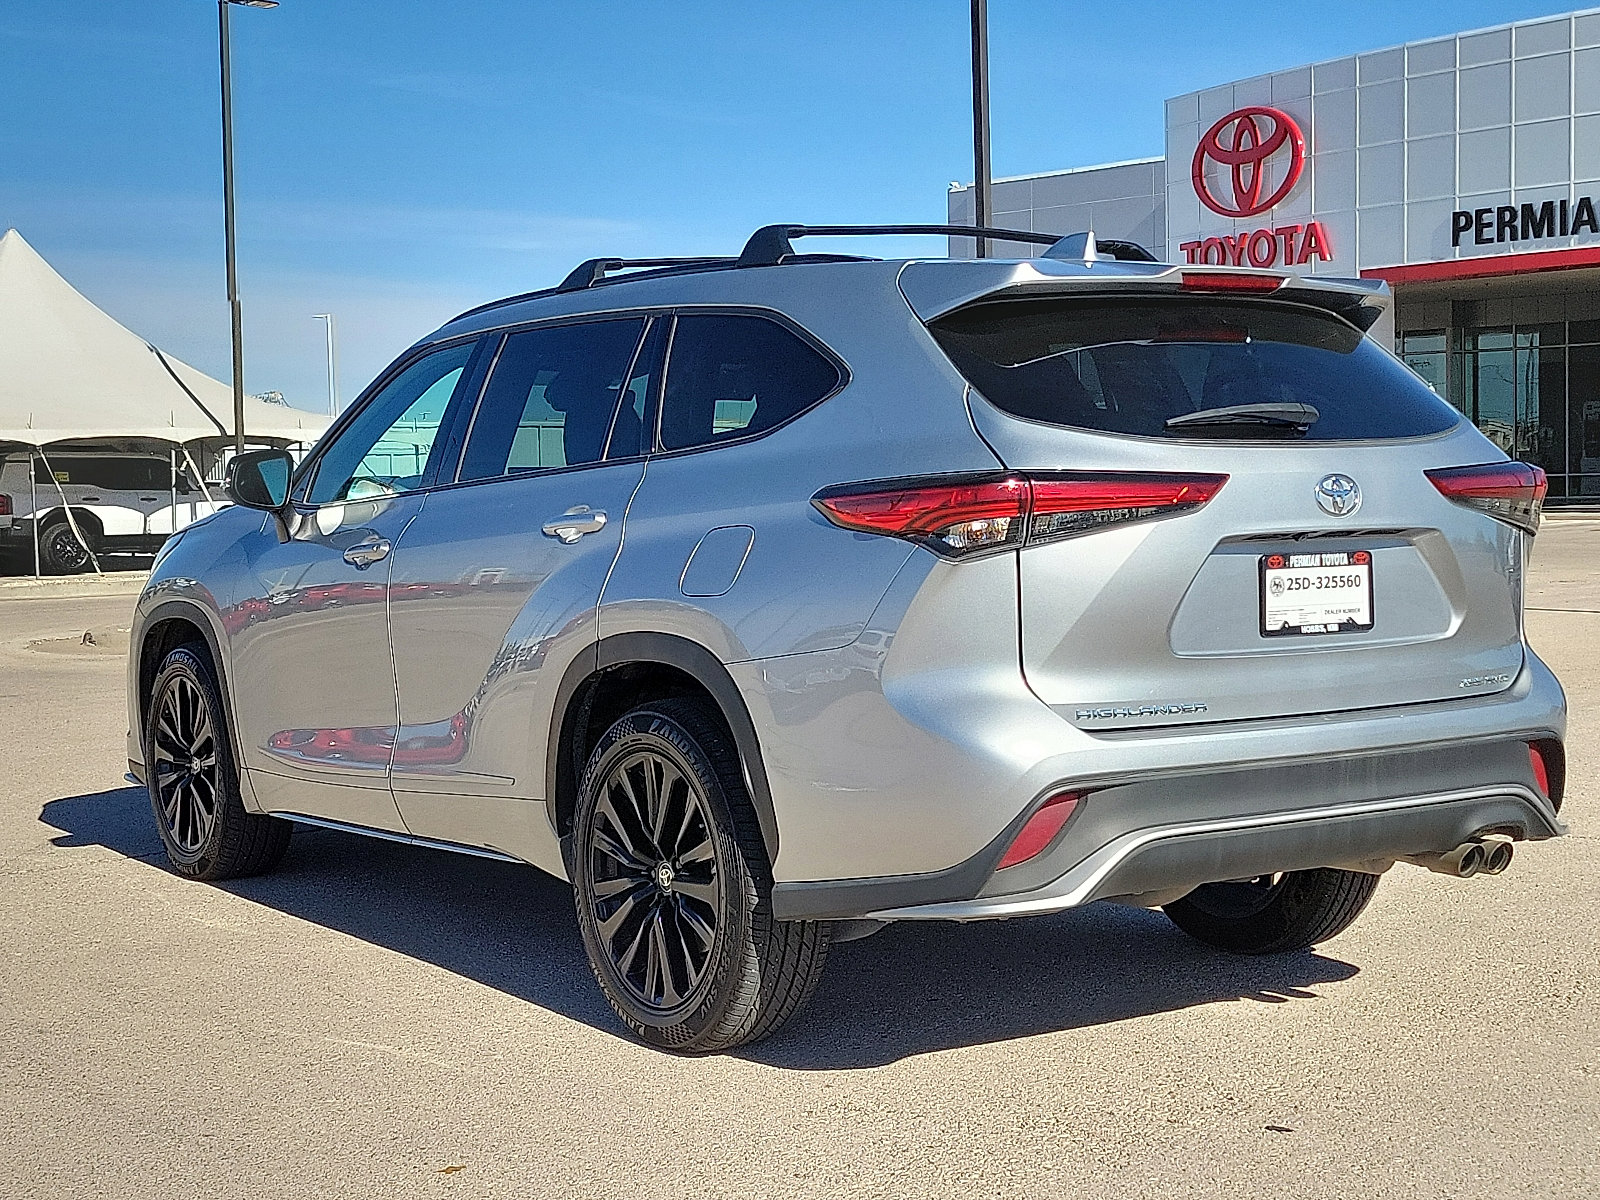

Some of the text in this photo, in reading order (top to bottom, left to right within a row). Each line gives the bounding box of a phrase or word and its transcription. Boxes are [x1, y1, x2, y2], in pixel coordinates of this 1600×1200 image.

[1179, 221, 1332, 268] TOYOTA
[1289, 552, 1349, 568] PERMIAN TOYOTA
[1286, 574, 1361, 591] 25D-325560
[1075, 702, 1209, 720] HIGHLANDER
